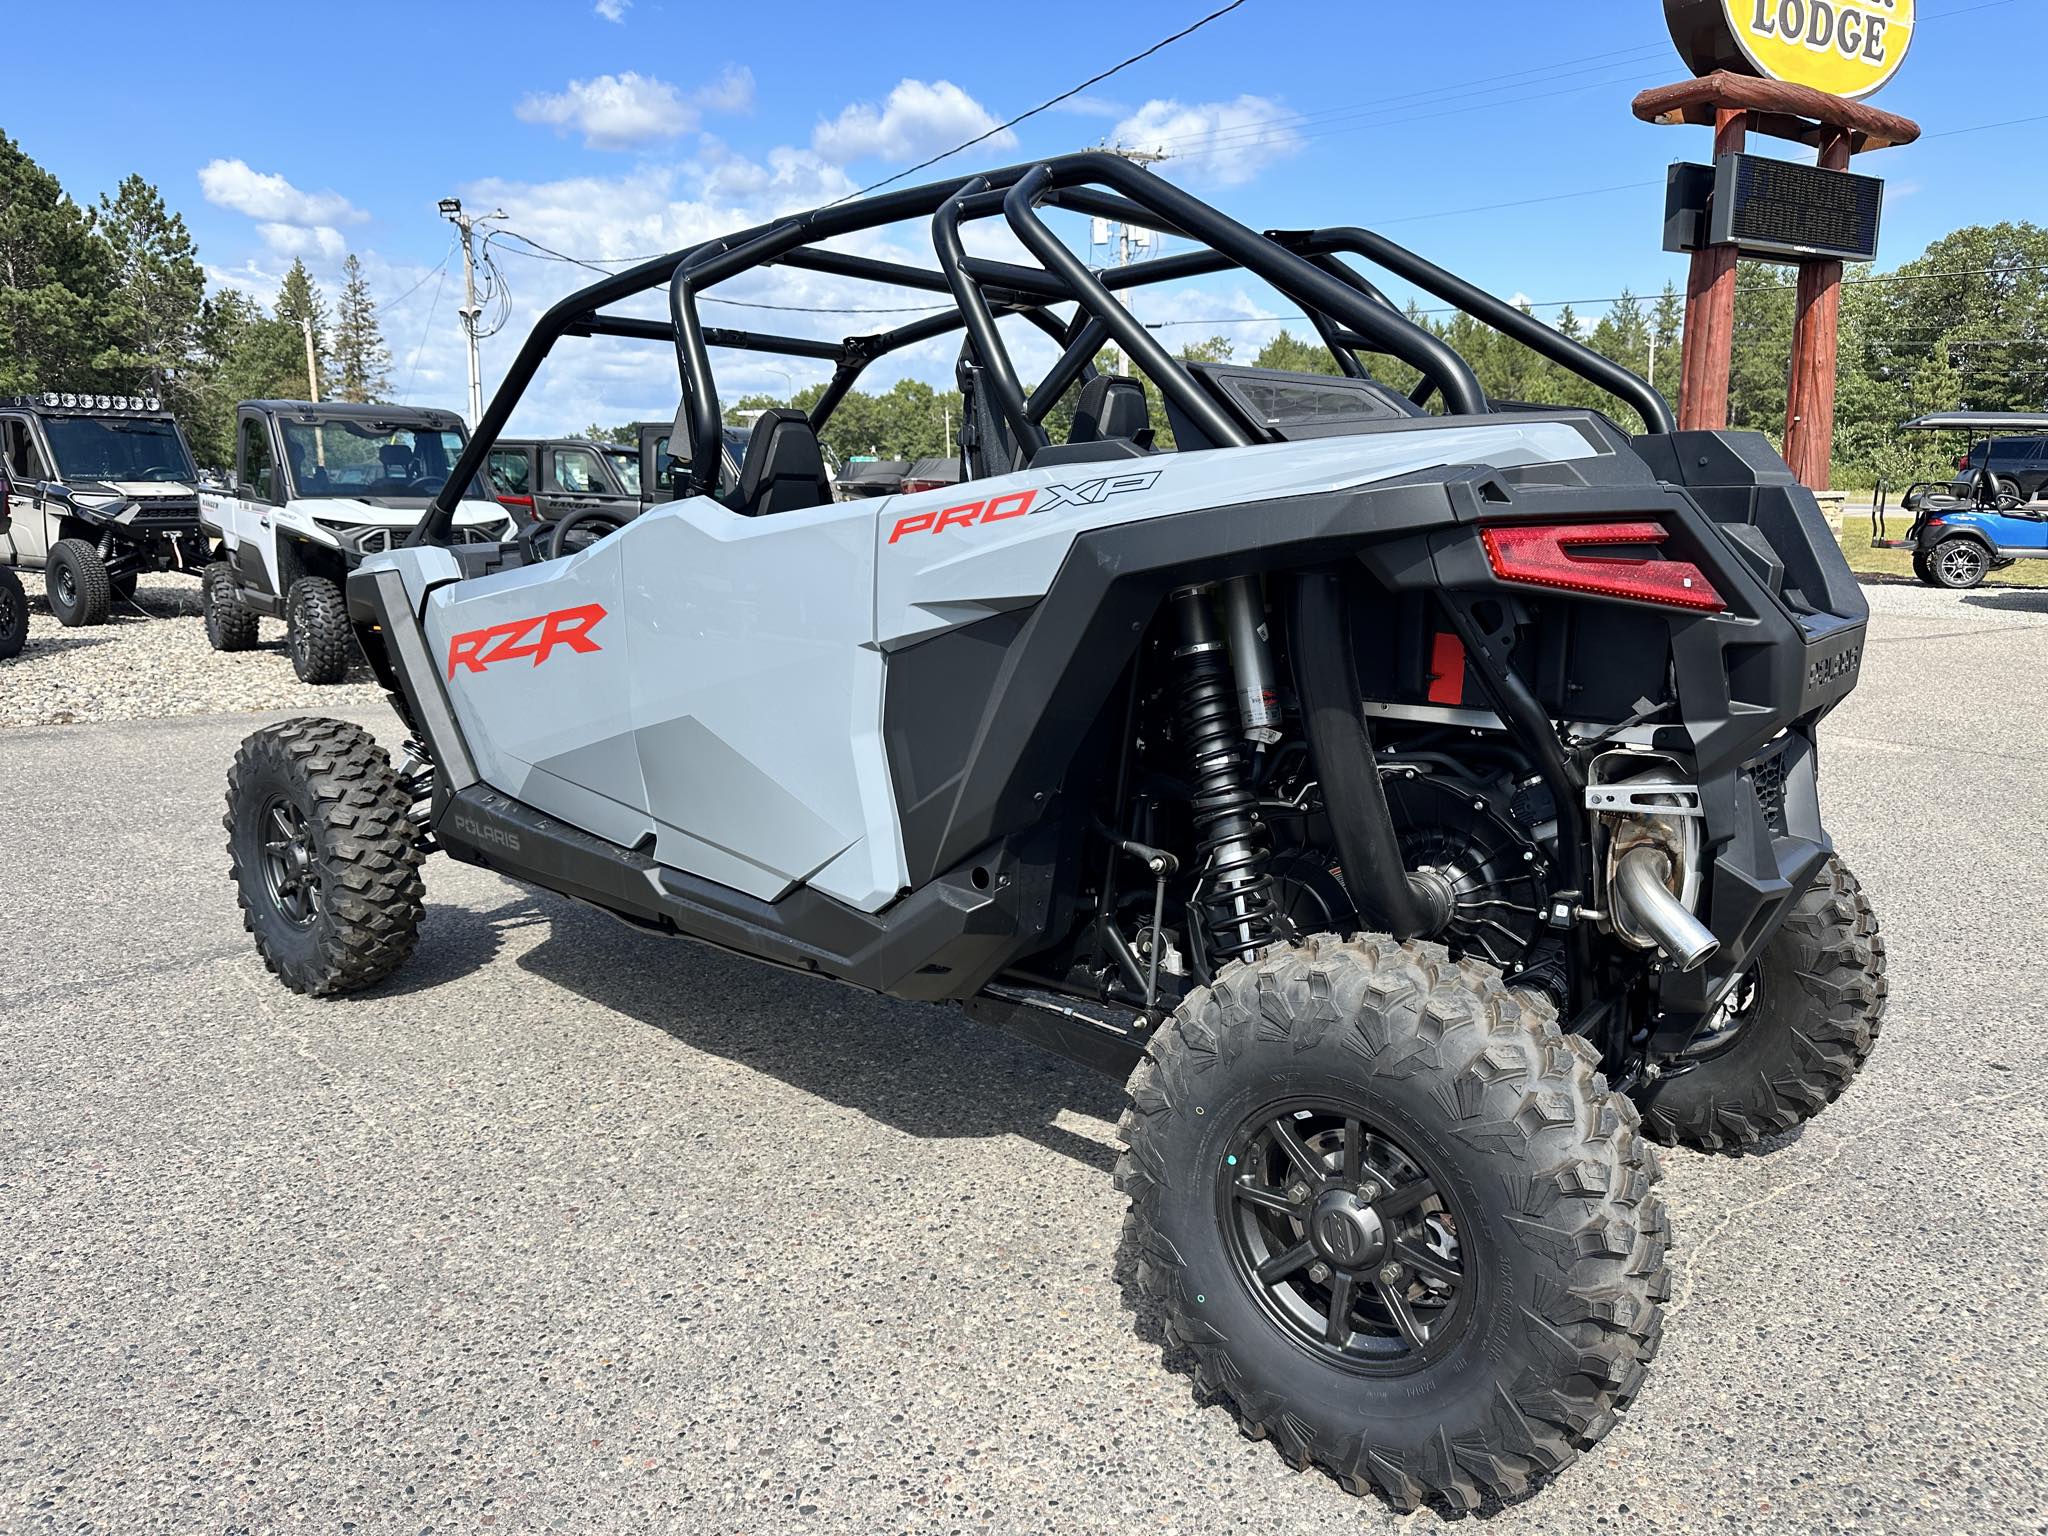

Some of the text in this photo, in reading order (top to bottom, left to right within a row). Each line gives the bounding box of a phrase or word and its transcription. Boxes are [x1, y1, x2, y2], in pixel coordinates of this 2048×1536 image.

[1752, 0, 1886, 62] LODGE
[888, 470, 1163, 544] PRO XP
[448, 603, 608, 683] RZR
[1808, 646, 1858, 690] POLARIS
[454, 815, 520, 851] POLARIS
